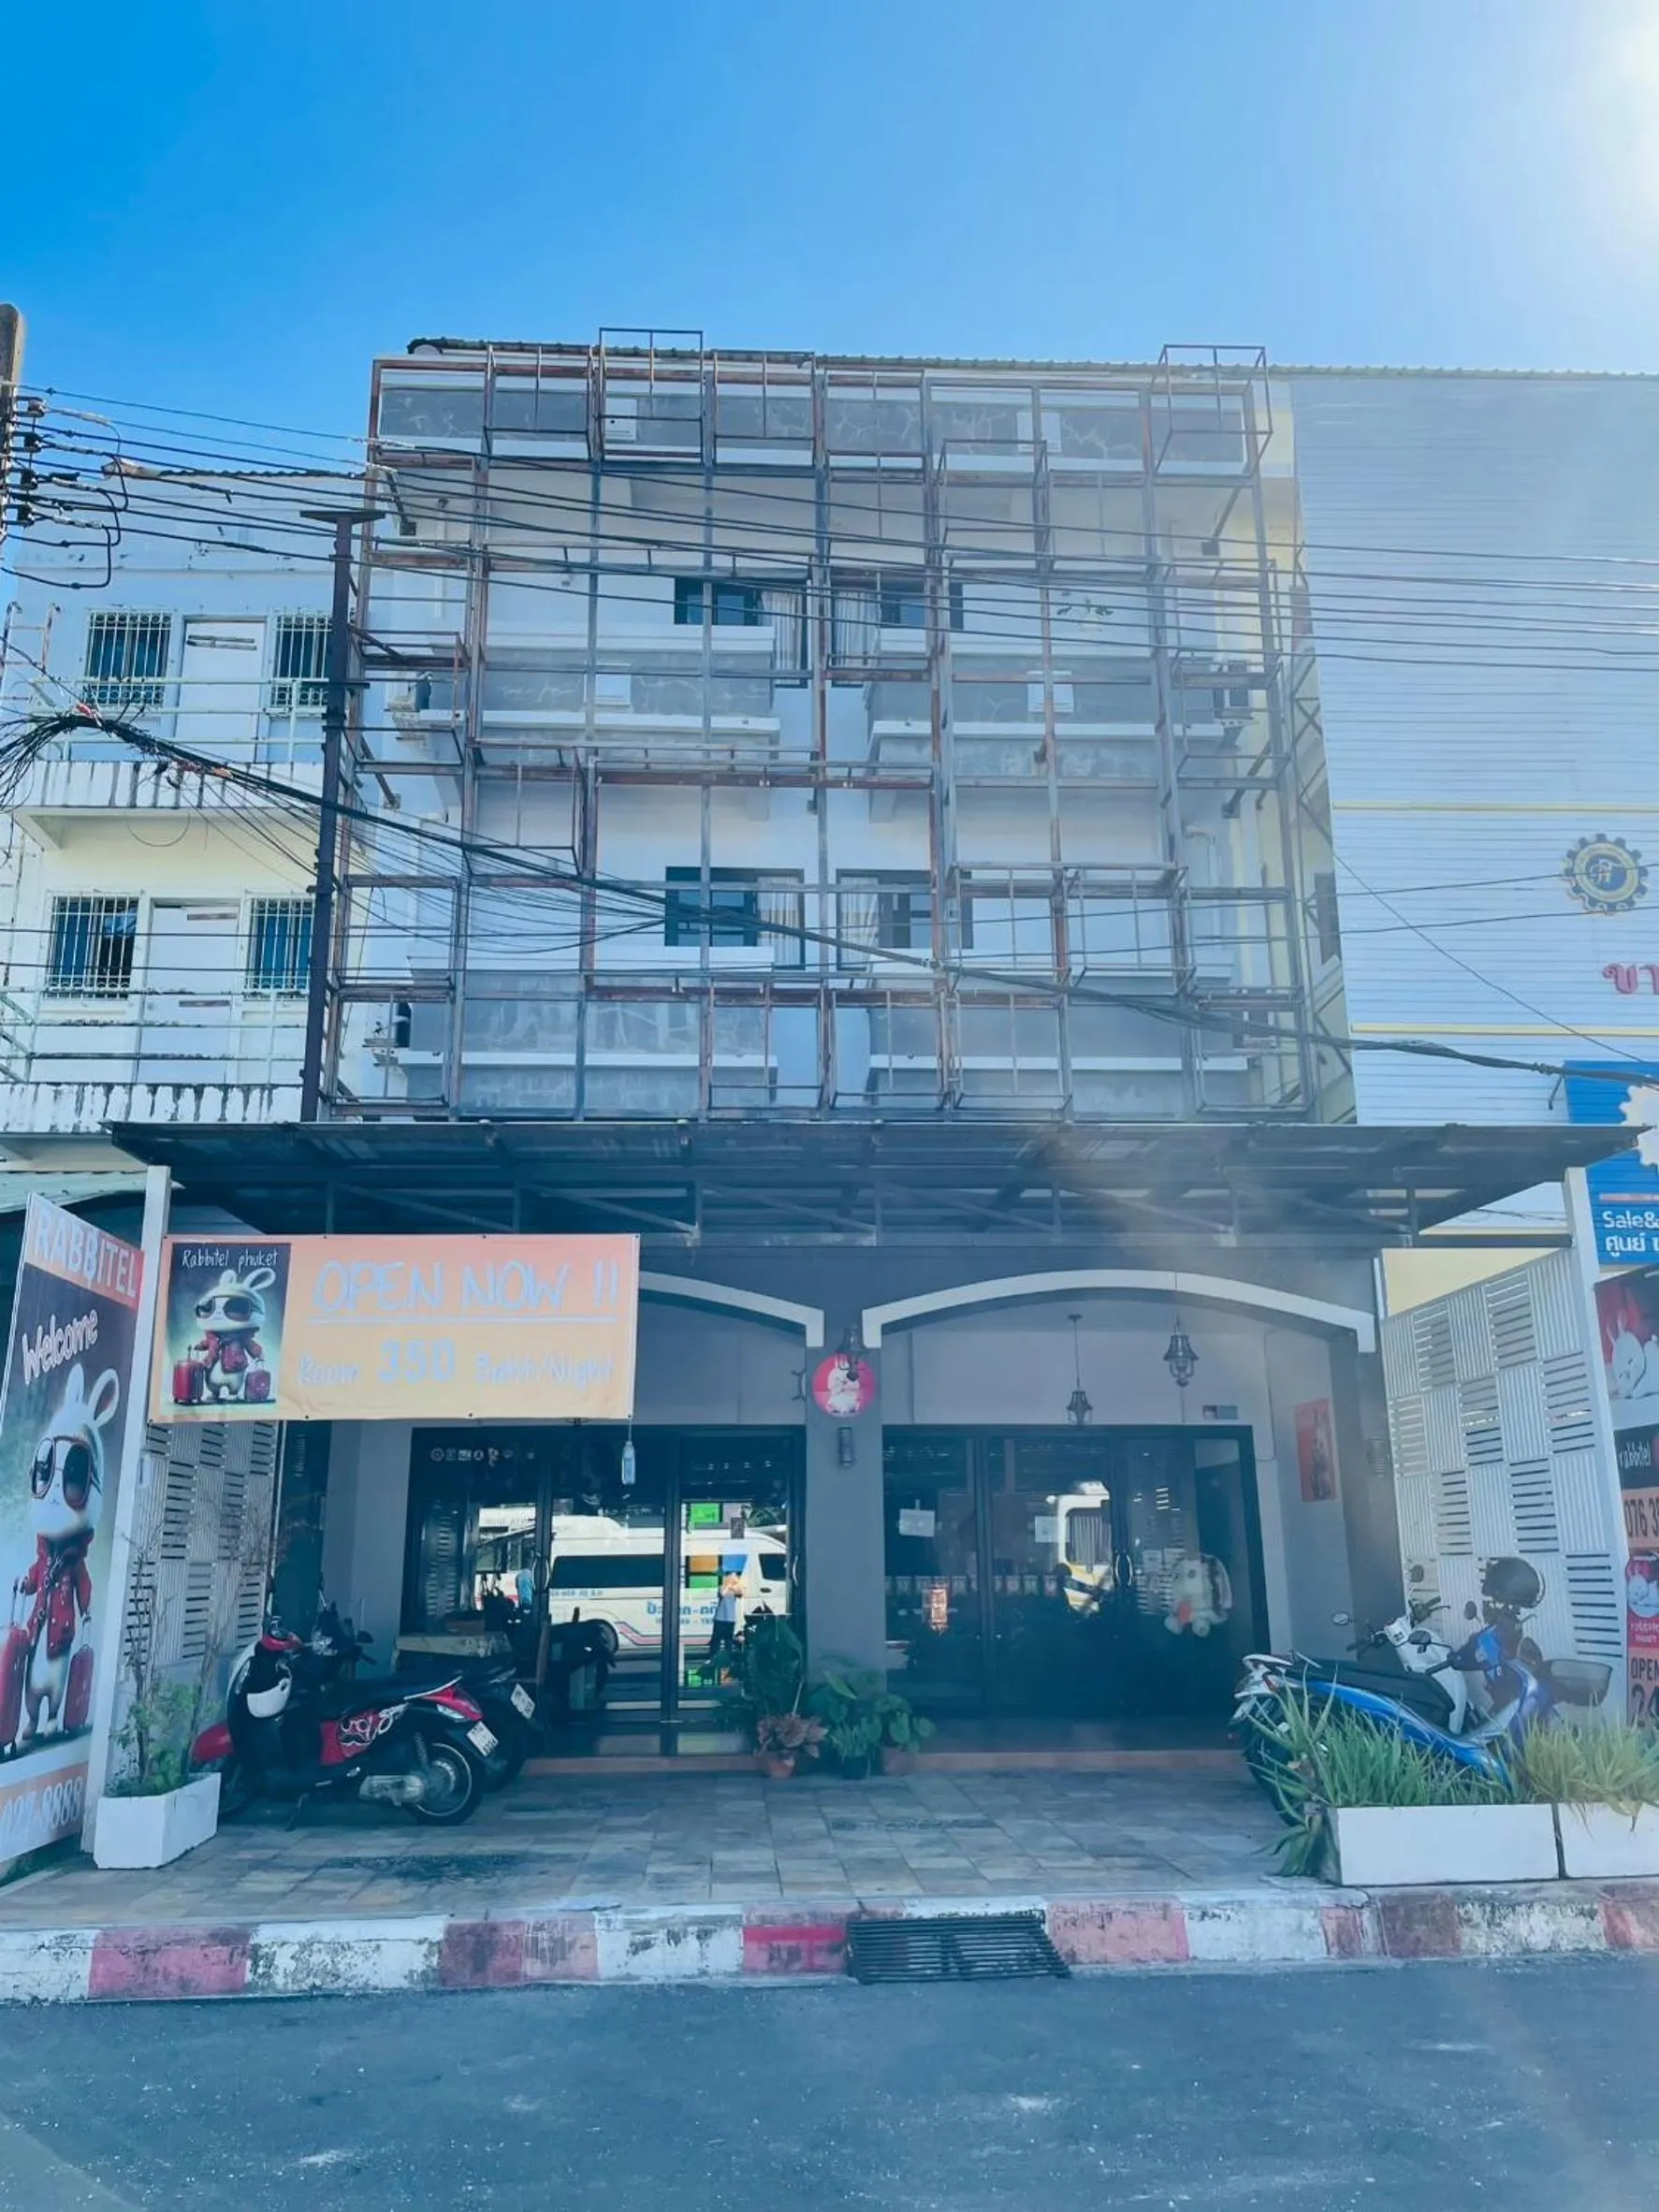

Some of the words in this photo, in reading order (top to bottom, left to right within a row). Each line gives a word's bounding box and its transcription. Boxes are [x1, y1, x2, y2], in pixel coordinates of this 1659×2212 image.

[35, 1207, 137, 1298] RABBITEL
[182, 1247, 229, 1268] Rabbitel
[238, 1247, 278, 1273] phuket
[1605, 1232, 1646, 1258] ศูนย์
[312, 1260, 445, 1312] OPEN
[461, 1259, 573, 1310] NOW
[22, 1310, 98, 1385] Welcome
[298, 1353, 361, 1385] Room
[378, 1338, 456, 1384] 350
